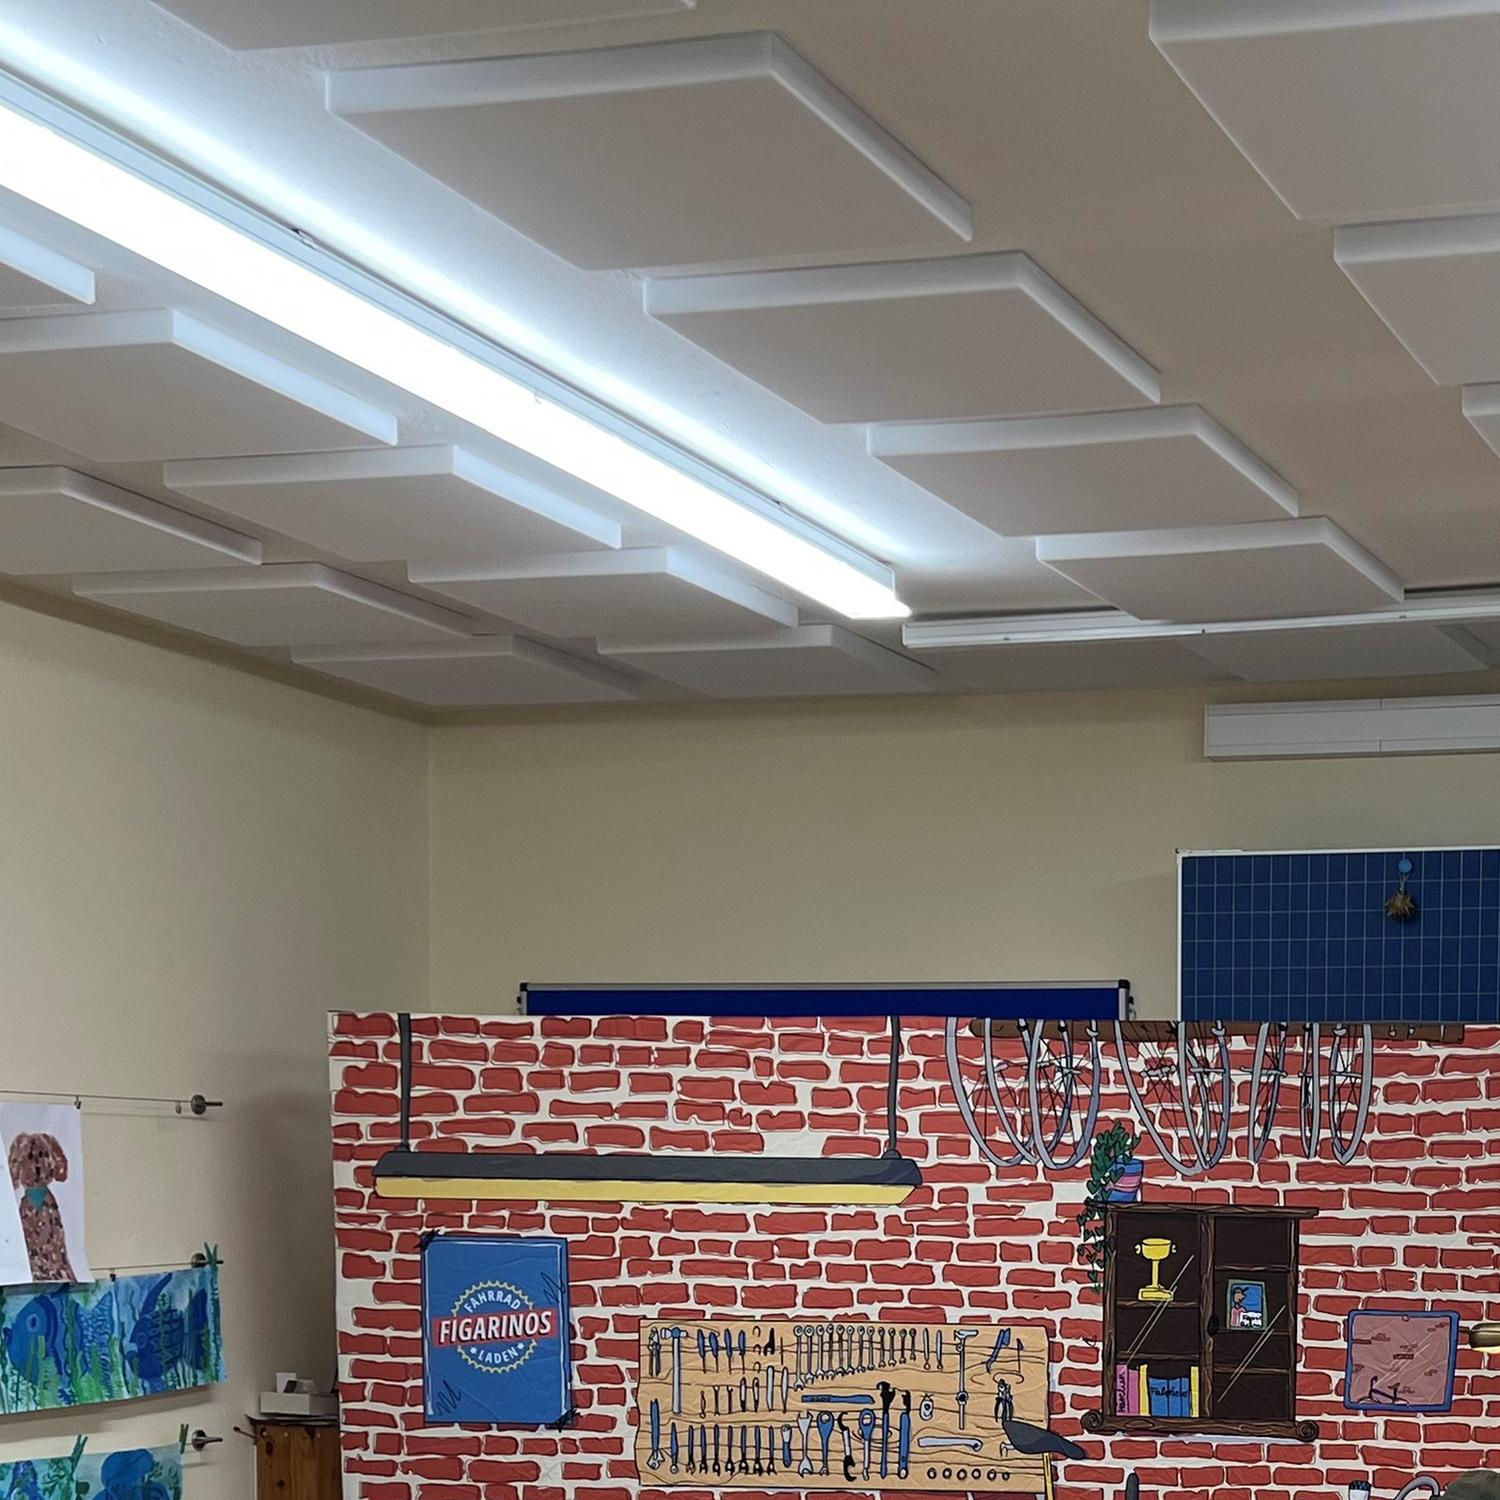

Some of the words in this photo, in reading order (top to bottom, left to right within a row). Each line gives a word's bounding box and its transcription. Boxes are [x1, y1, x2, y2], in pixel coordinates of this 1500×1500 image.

[464, 1290, 521, 1313] FAHRRAD
[439, 1311, 552, 1344] FIGARINOS
[478, 1347, 519, 1364] LADEN
